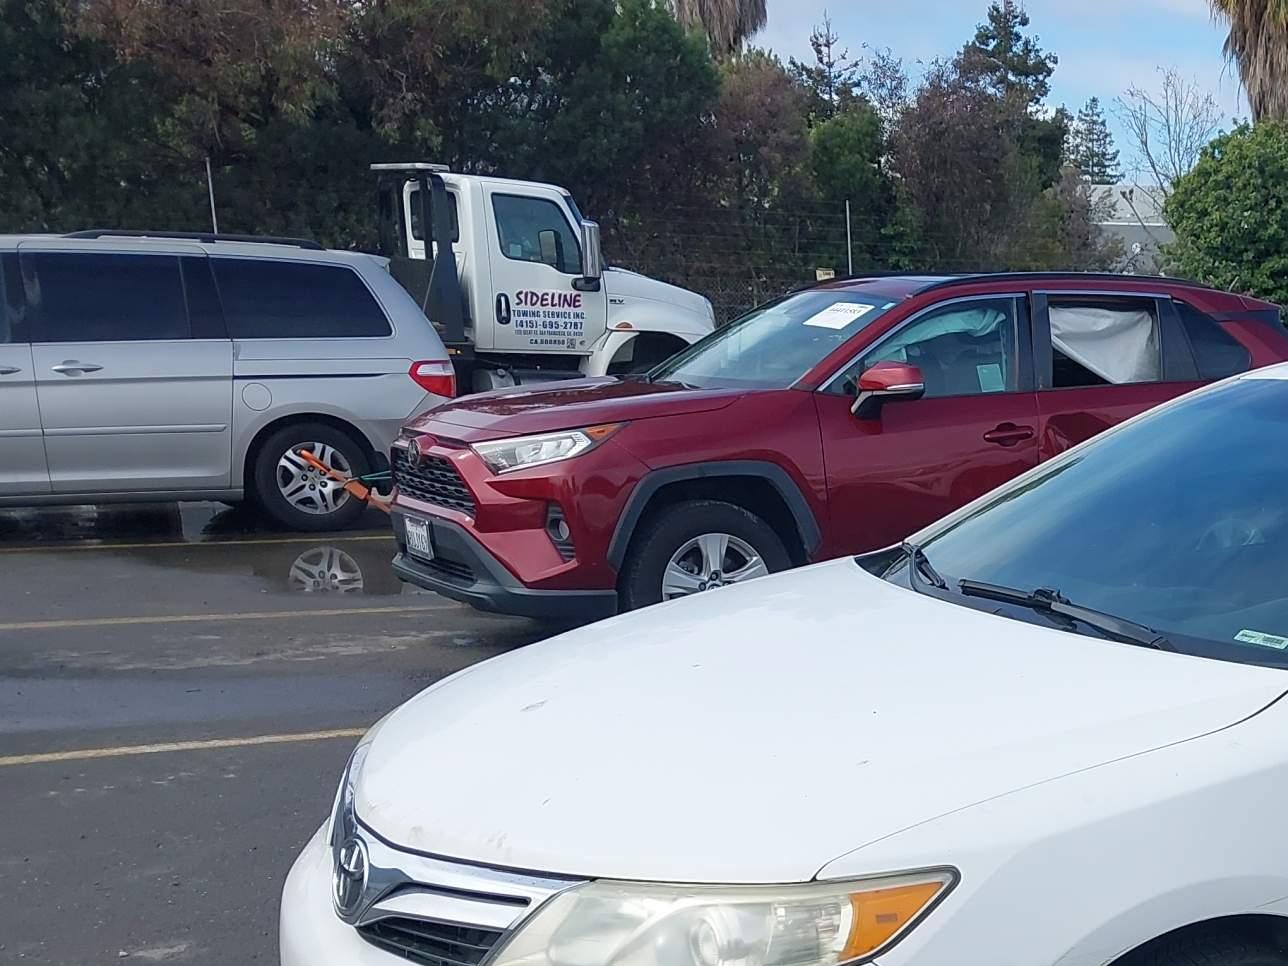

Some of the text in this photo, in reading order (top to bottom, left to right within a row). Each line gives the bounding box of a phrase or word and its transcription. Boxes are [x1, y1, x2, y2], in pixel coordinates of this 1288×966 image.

[515, 290, 582, 308] SIDELINE
[512, 309, 541, 318] TOWING
[542, 310, 572, 319] SERVICE
